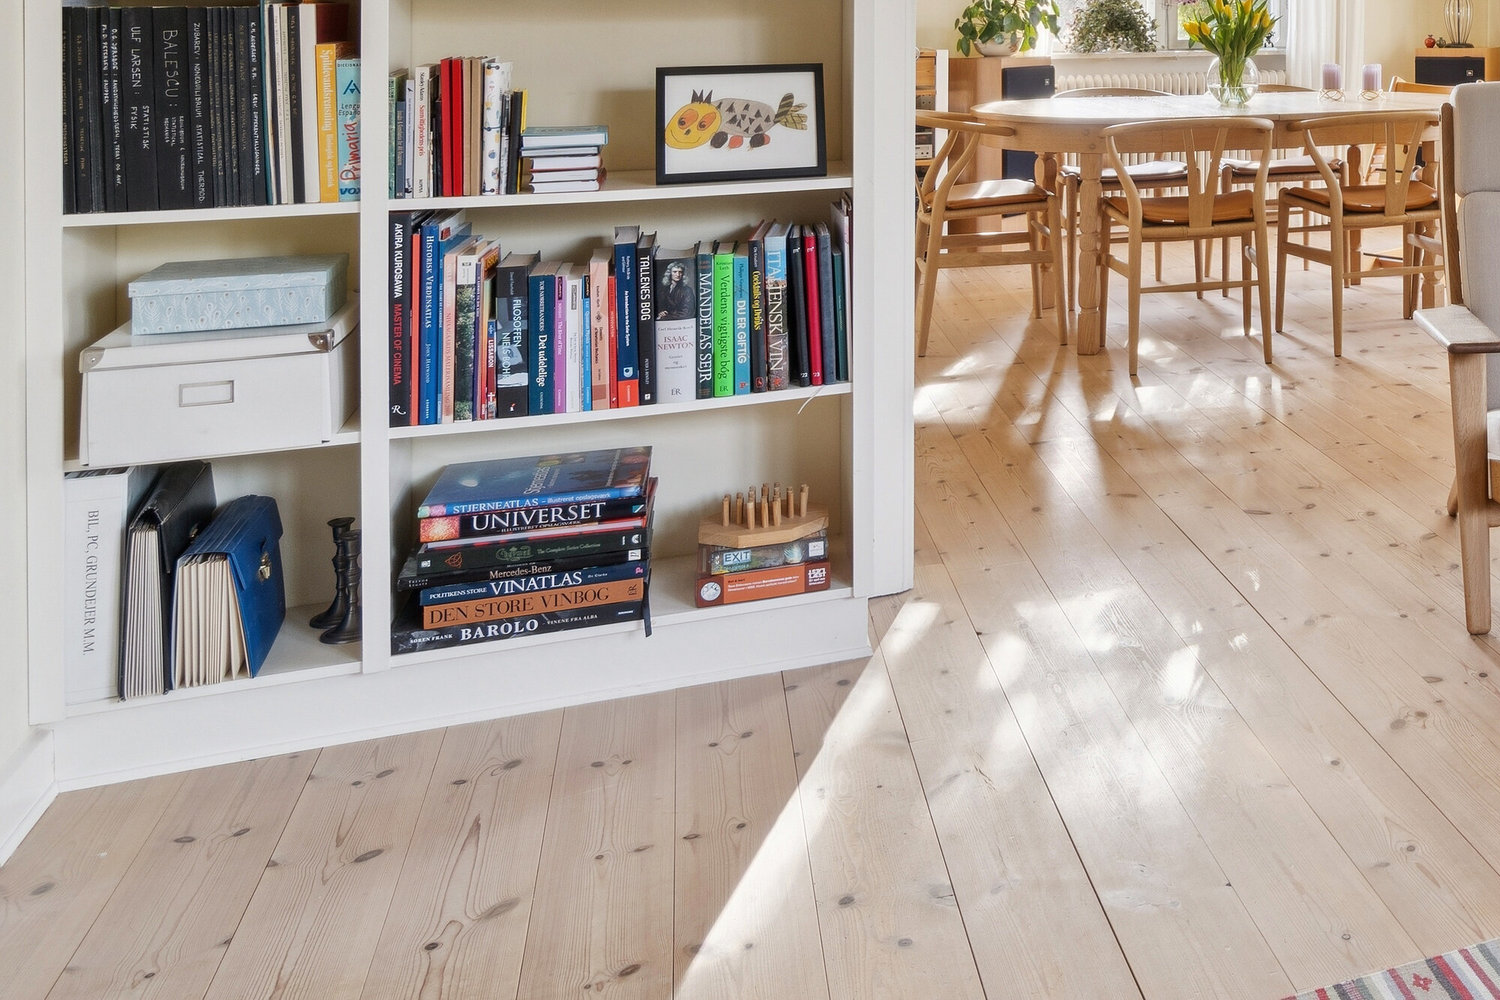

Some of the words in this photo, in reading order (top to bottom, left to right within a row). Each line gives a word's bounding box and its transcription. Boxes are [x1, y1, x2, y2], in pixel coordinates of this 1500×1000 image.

[131, 26, 141, 43] ULF
[131, 48, 141, 88] LARSEN
[163, 29, 179, 98] BALESCU
[320, 49, 333, 131] Spildevandsrensning
[130, 106, 138, 129] FYSIK
[196, 124, 204, 164] STATISTICAL
[394, 223, 403, 249] AKIRA
[425, 235, 434, 273] HISTORISK
[394, 250, 403, 298] KUROSAWA
[640, 255, 650, 300] TALLENES
[425, 275, 433, 328] VERDENSATLAS
[720, 275, 730, 314] Verdens
[737, 300, 746, 315] DU
[393, 304, 402, 333] MASTER
[512, 299, 521, 347] FILOSOFFEN
[640, 302, 651, 321] BOG
[699, 272, 713, 350] MANDELAS
[737, 317, 746, 329] ER
[393, 335, 401, 350] OF
[501, 333, 510, 354] NIELS
[538, 334, 547, 349] Det
[657, 342, 694, 351] NEWTON
[717, 317, 729, 358] vigtigste
[738, 332, 750, 364] GIFTIG
[393, 352, 402, 385] CINEMA
[501, 357, 510, 380] BOHR
[536, 351, 547, 387] udelelige
[699, 354, 712, 383] SEJR
[769, 339, 784, 372] VIN
[452, 497, 539, 514] STJERNEATLAS
[472, 501, 606, 531] UNIVERSET
[86, 510, 99, 533] BIL,
[85, 536, 99, 554] PC,
[724, 551, 750, 563] EXIT
[429, 589, 465, 599] POLITIKENS
[466, 587, 487, 595] STORE
[489, 571, 583, 595] VINATLAS
[489, 564, 553, 580] Mercedes-Benz
[84, 556, 98, 626] GRUNDEJER
[429, 607, 470, 625] DEN
[474, 596, 534, 618] STORE
[541, 587, 610, 608] VINBOG
[82, 628, 96, 656] M.M.
[460, 619, 539, 641] BAROLO
